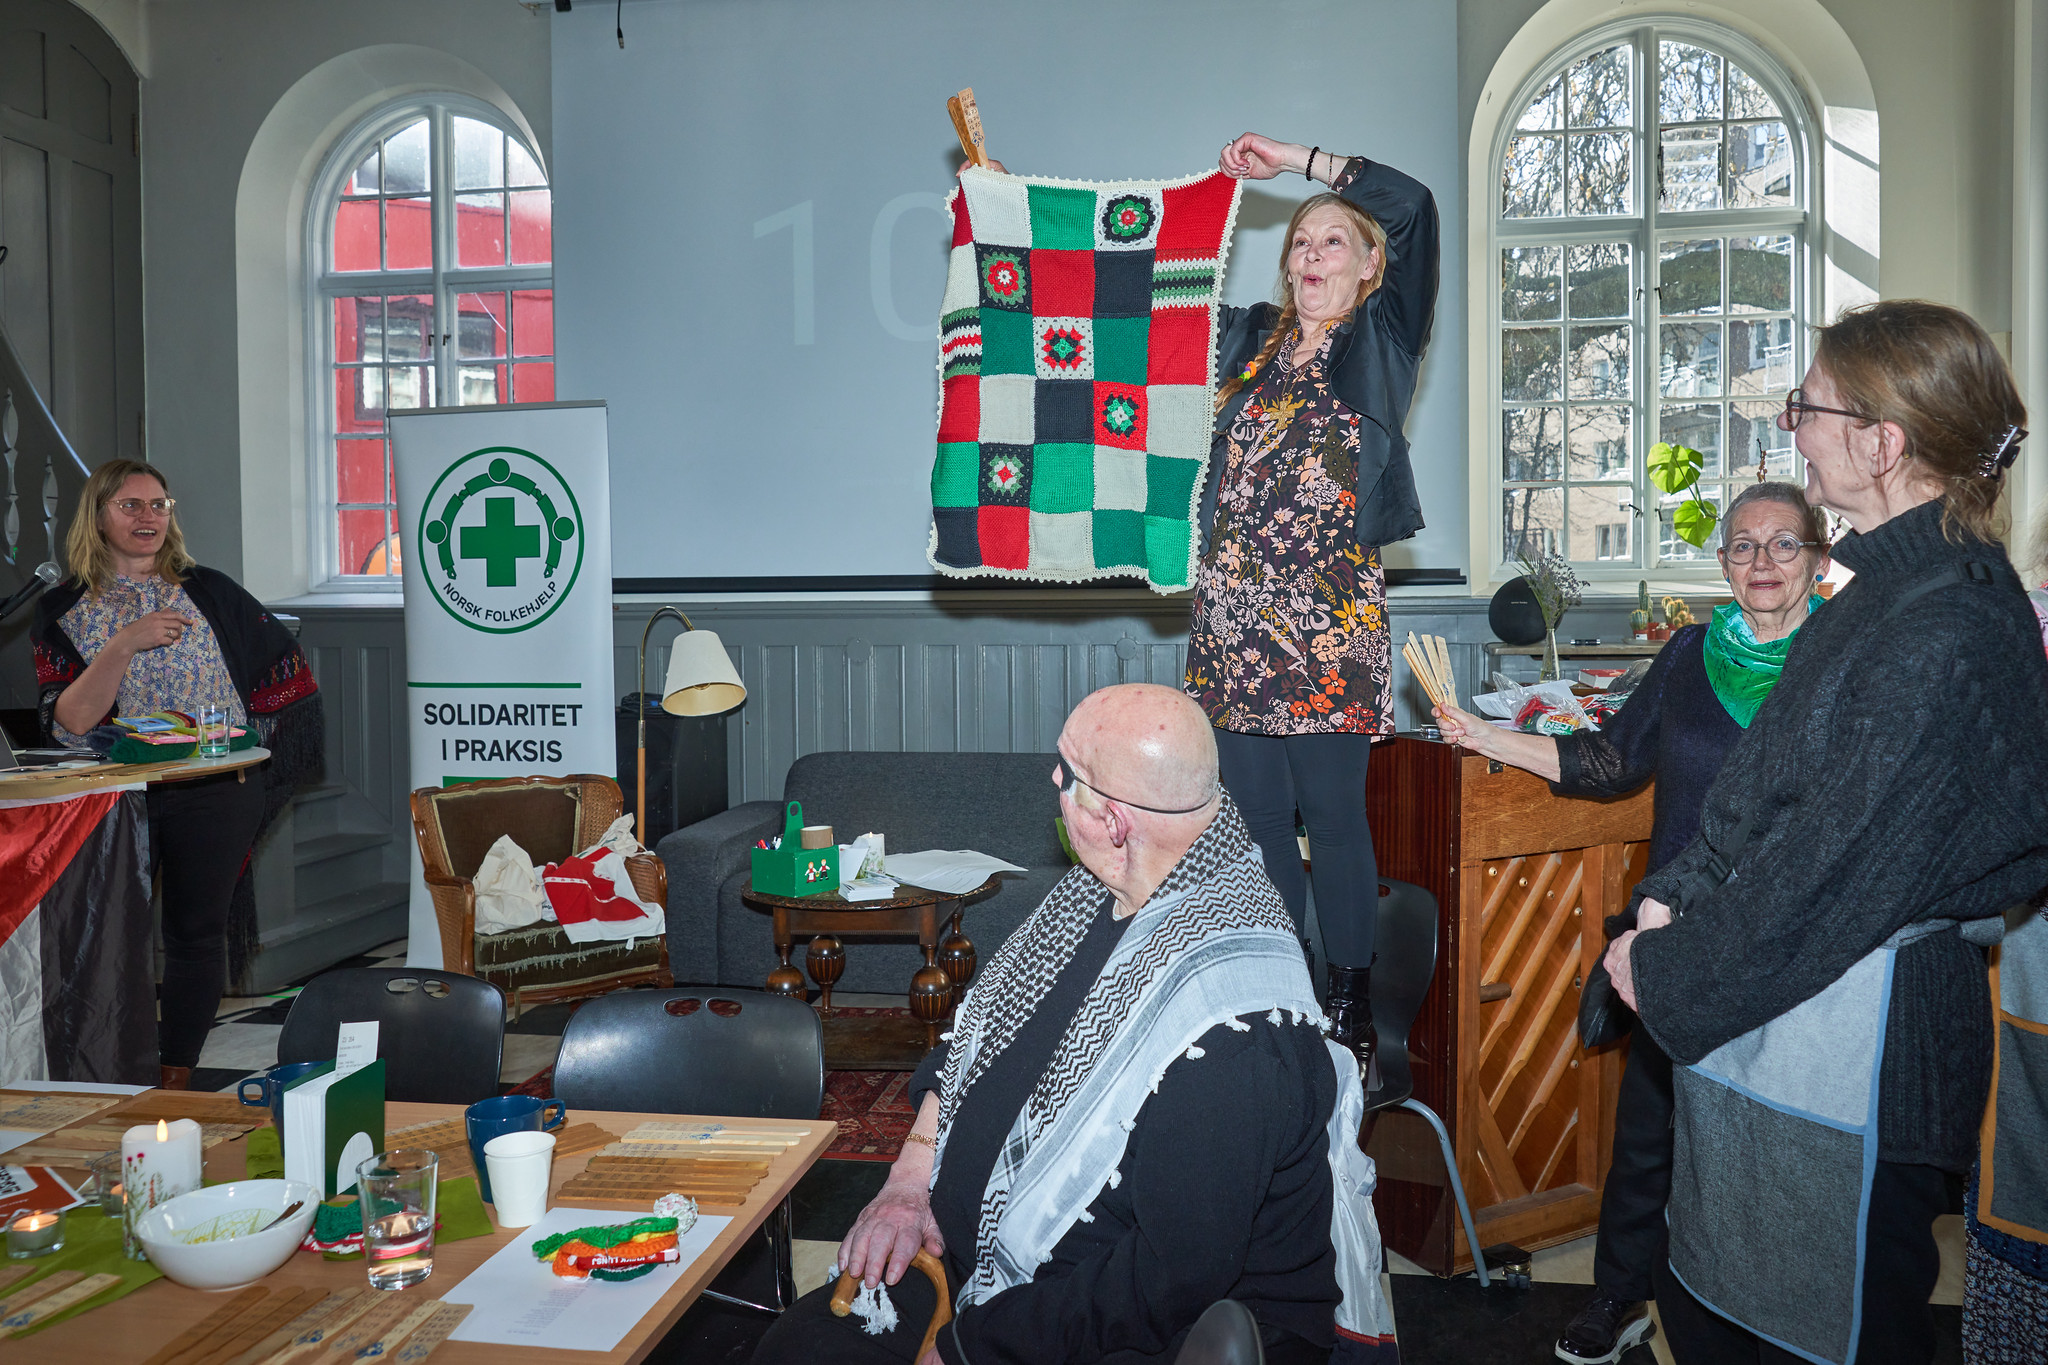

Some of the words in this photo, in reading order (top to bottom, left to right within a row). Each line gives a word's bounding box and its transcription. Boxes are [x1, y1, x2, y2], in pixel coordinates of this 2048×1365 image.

[443, 582, 483, 618] NORSK
[484, 581, 557, 622] FOLKEHJELP
[423, 702, 583, 727] SOLIDARITET
[441, 738, 447, 761] I
[454, 739, 563, 763] PRAKSIS
